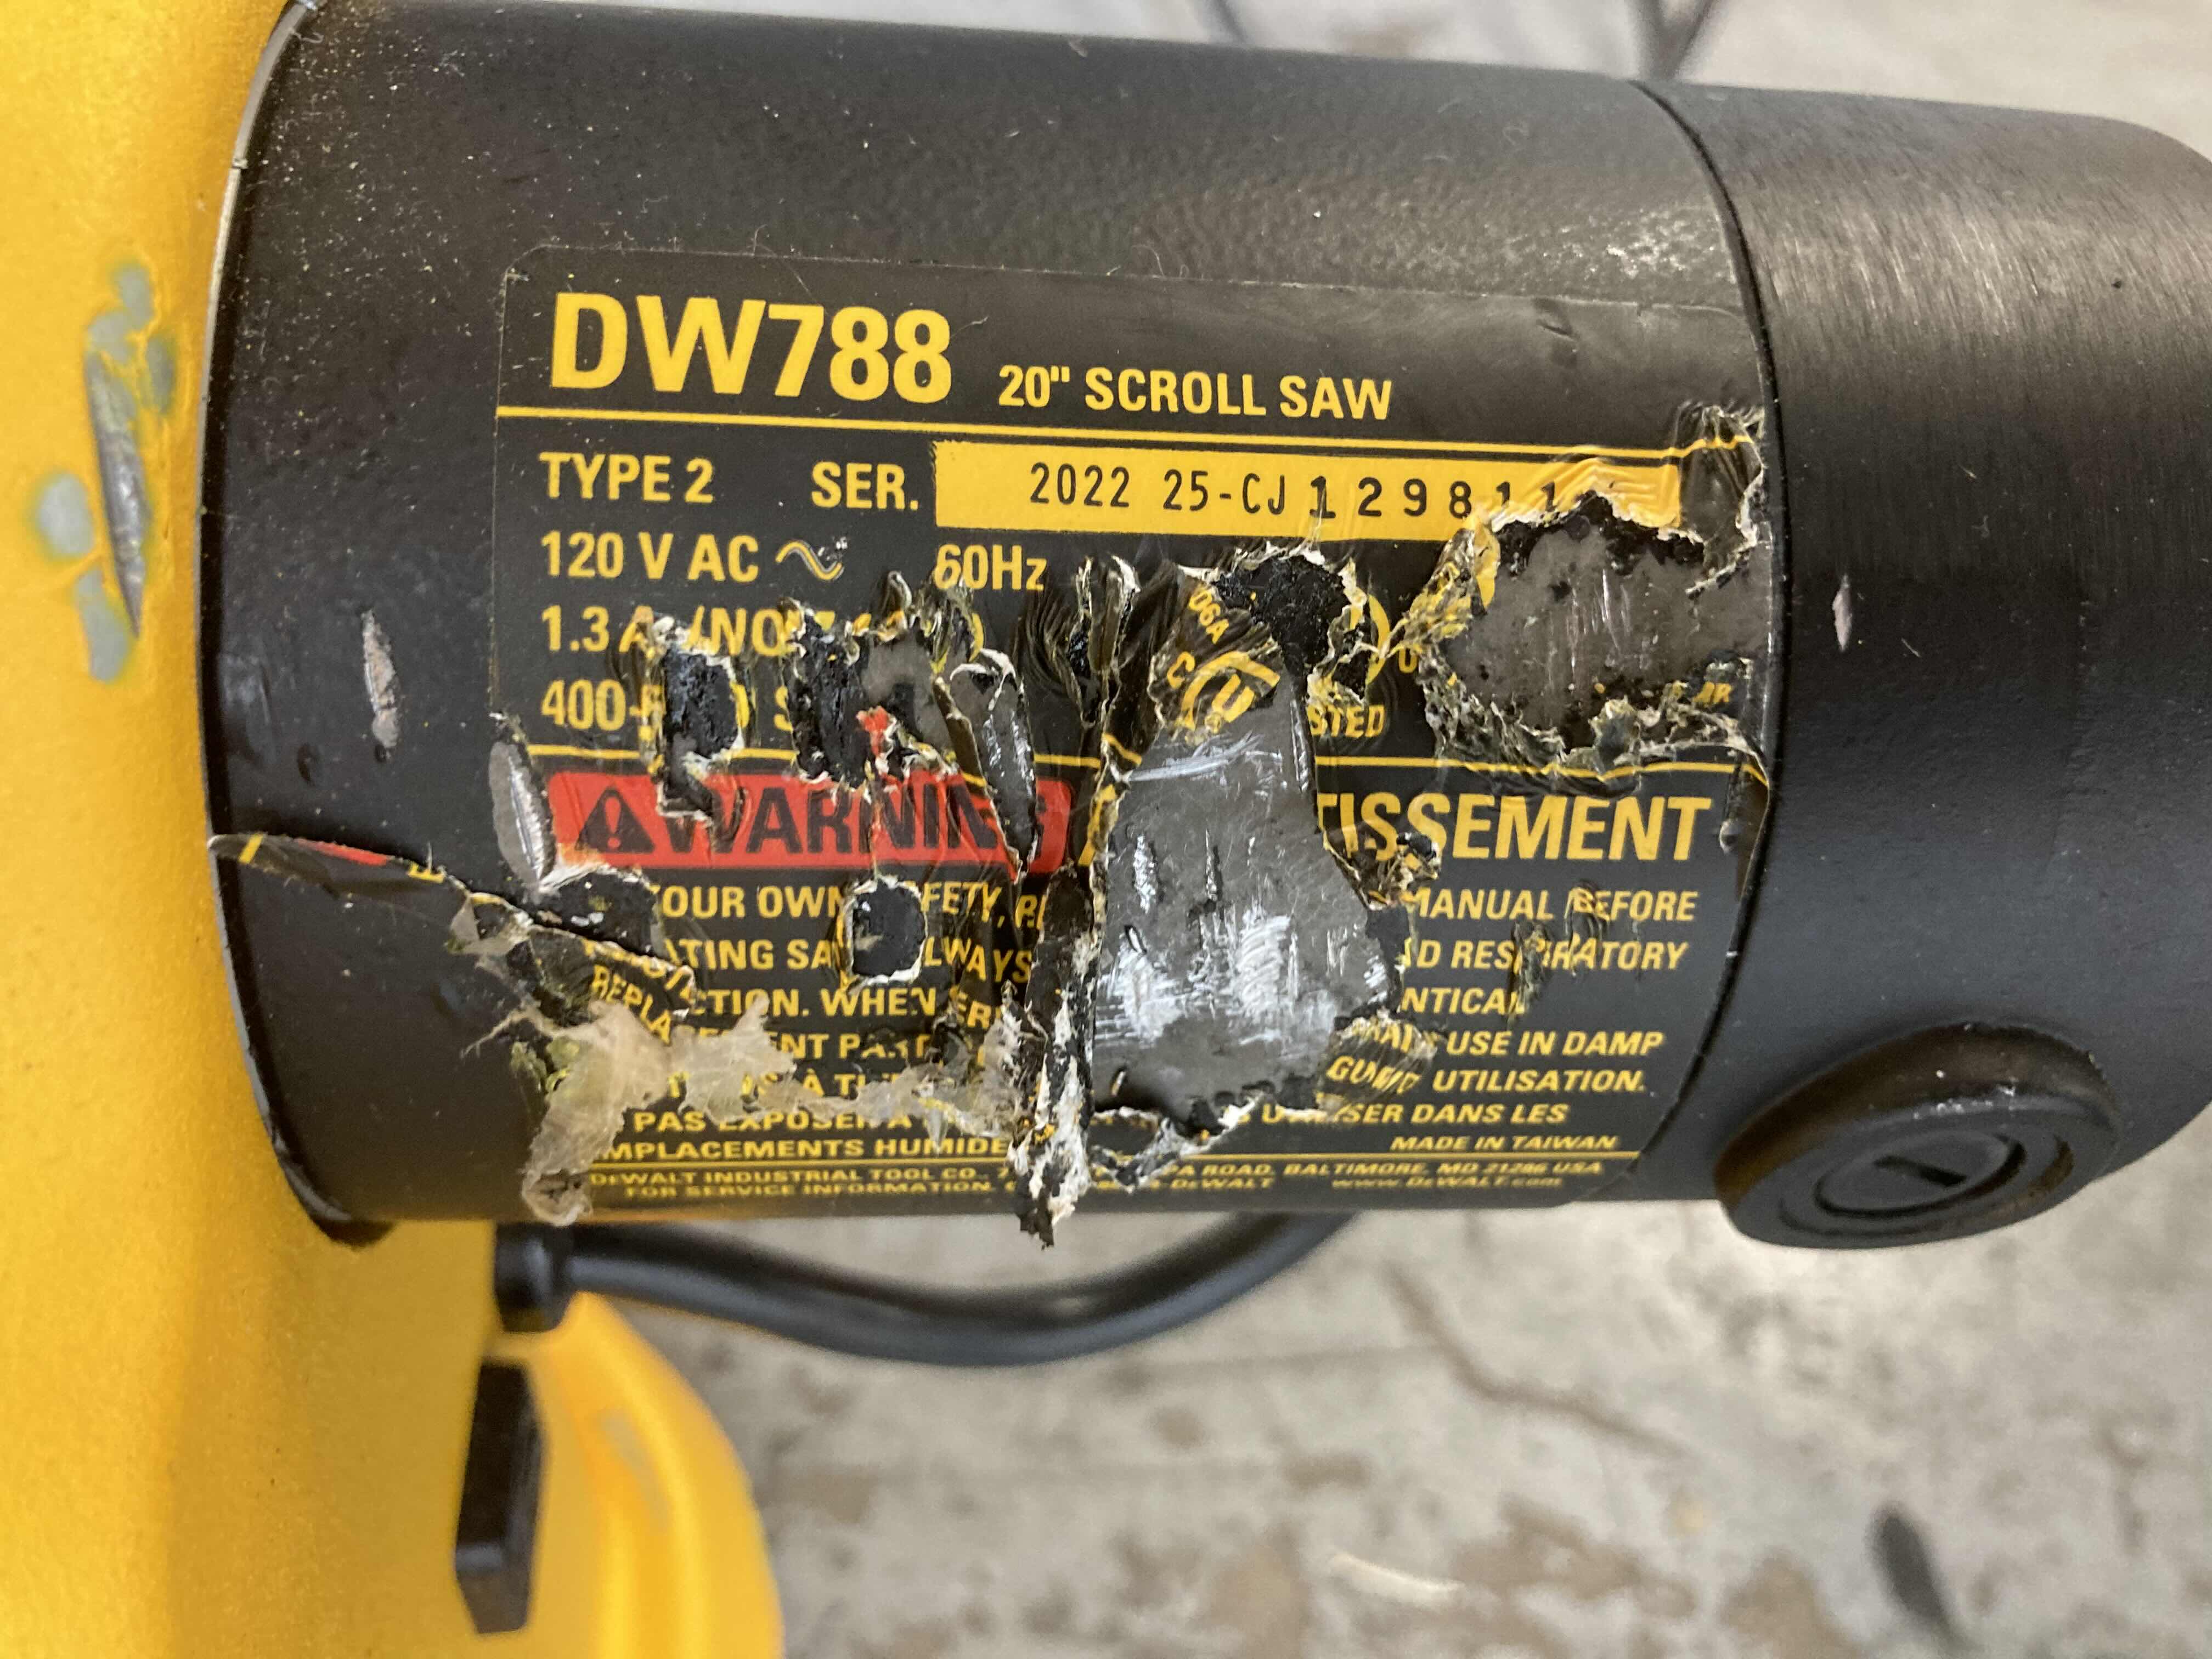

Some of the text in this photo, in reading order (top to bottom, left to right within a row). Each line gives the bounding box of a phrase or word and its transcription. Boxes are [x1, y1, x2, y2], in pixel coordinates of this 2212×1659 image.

[551, 292, 952, 404] DW788
[998, 364, 1393, 420] 20" SCROLL SAW
[539, 452, 715, 504] TYPE 2
[811, 461, 919, 511] SER.
[1029, 462, 1131, 509] 2022
[541, 530, 760, 583] 120 V AC
[933, 544, 1047, 591] 60Hz
[541, 605, 610, 651] 1.3
[1317, 791, 1712, 861] TISSEMENT
[650, 884, 747, 919] OUR
[1445, 1030, 1512, 1056] USE
[1517, 1031, 1557, 1056] IN
[1561, 1030, 1665, 1056] DAMP
[1410, 1103, 1505, 1124] DANS
[1510, 1103, 1570, 1124] LES
[602, 1138, 865, 1160] MPLACEMENTS
[1389, 1135, 1620, 1151] MADE IN TAIWAN
[626, 1186, 677, 1198] FOR
[684, 1184, 795, 1198] SERVICE
[704, 1169, 862, 1184] INDUSTRIAL
[868, 1166, 936, 1181] TOOL
[1436, 1161, 1481, 1175] MD
[1552, 1161, 1604, 1175] USA
